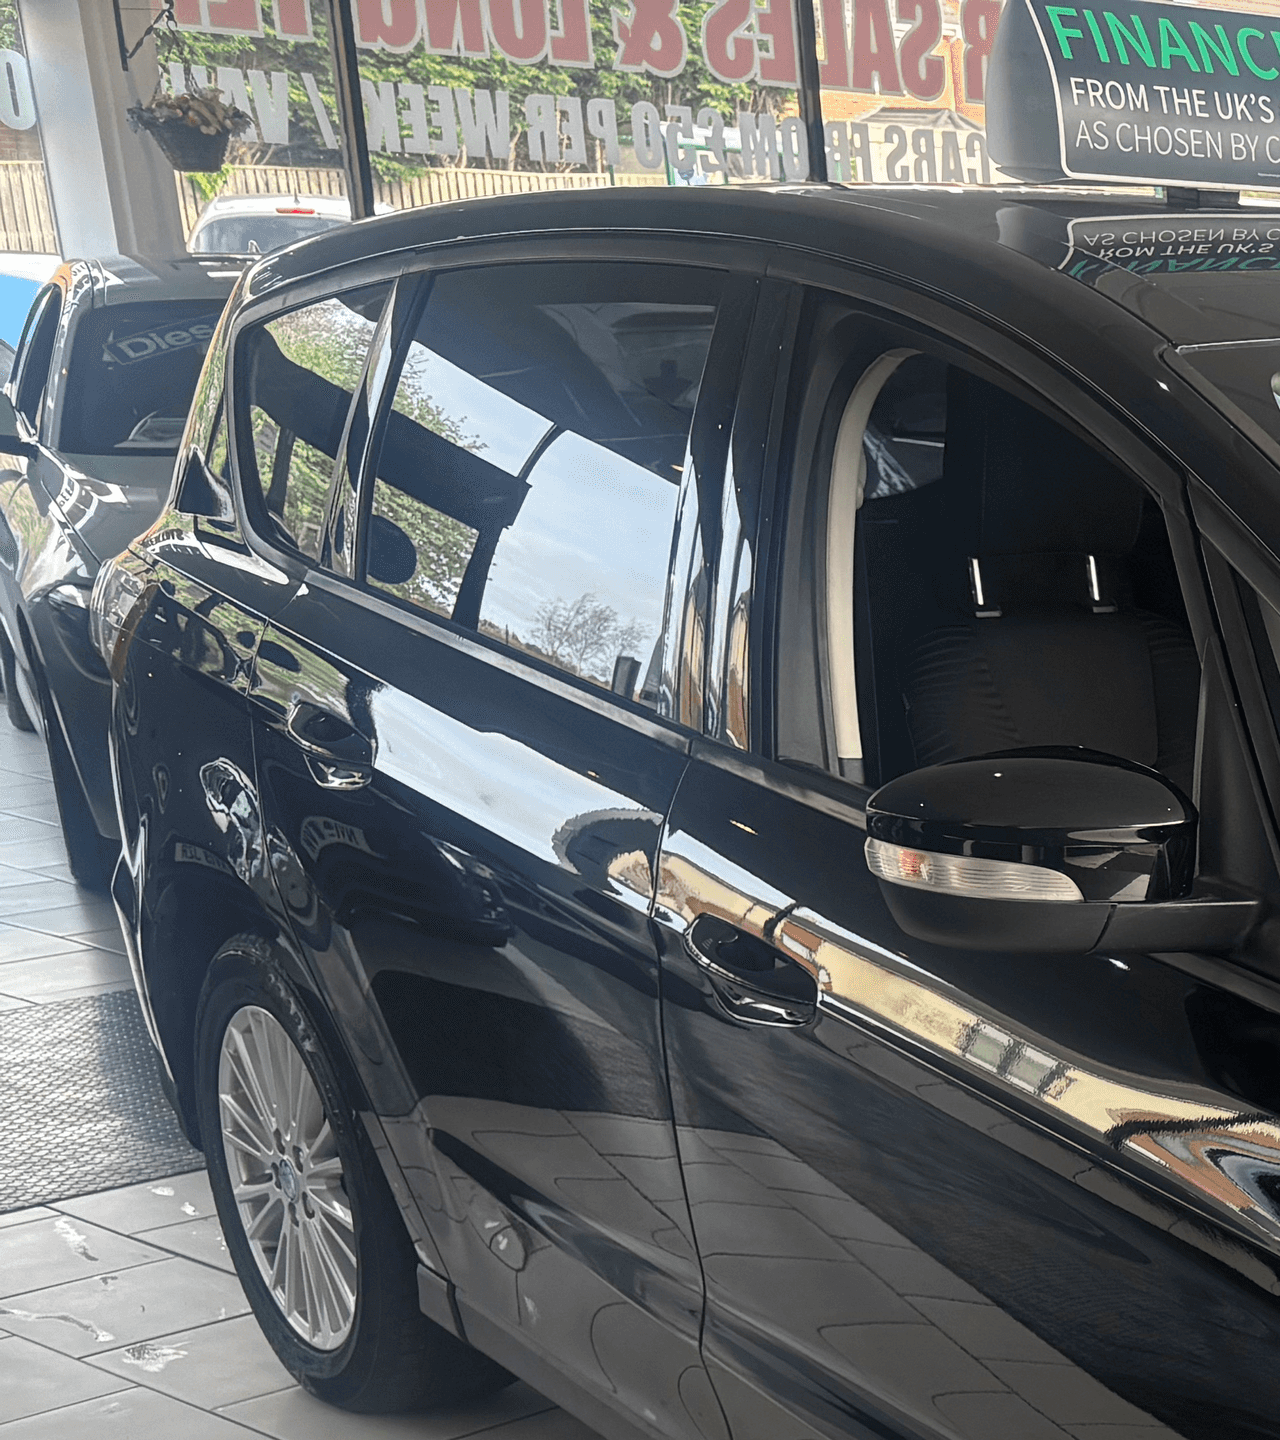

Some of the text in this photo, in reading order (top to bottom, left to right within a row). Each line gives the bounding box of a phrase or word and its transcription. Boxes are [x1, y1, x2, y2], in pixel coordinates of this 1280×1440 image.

[1069, 77, 1150, 112] FROM
[1153, 85, 1210, 118] THE
[1214, 91, 1275, 124] UK'S
[1075, 120, 1109, 150] AS
[1116, 123, 1223, 160] CHOSEN
[1230, 132, 1259, 162] BY
